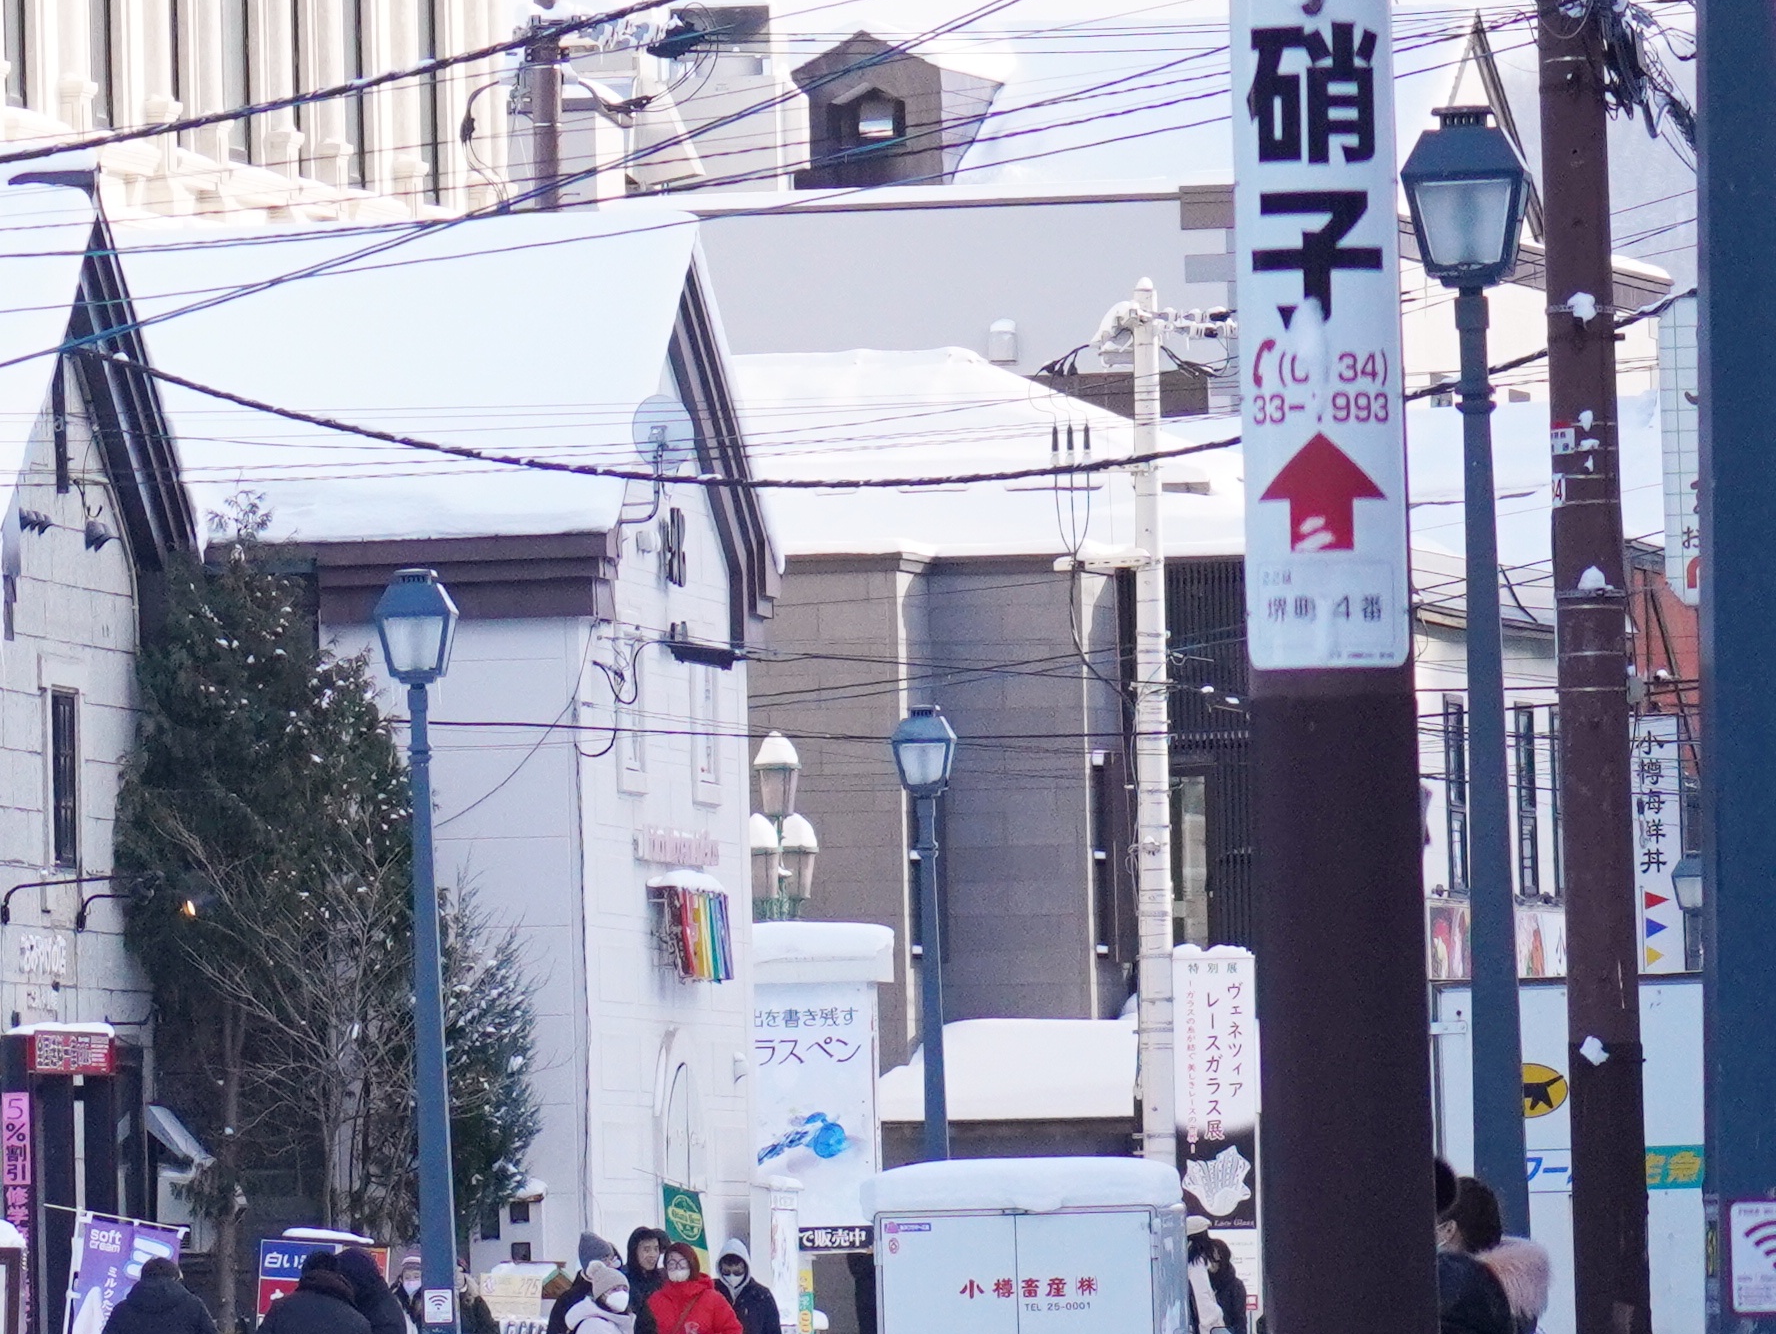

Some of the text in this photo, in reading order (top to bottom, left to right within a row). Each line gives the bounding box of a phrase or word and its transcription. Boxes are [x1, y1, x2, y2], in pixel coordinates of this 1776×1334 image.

[1188, 963, 1238, 975] 特別展
[1227, 981, 1243, 1098] ヴェネツィア
[1205, 992, 1225, 1141] レースガラス展
[90, 1228, 122, 1243] soft
[89, 1240, 121, 1253] cream
[1025, 1302, 1091, 1312] TEL 25-0001
